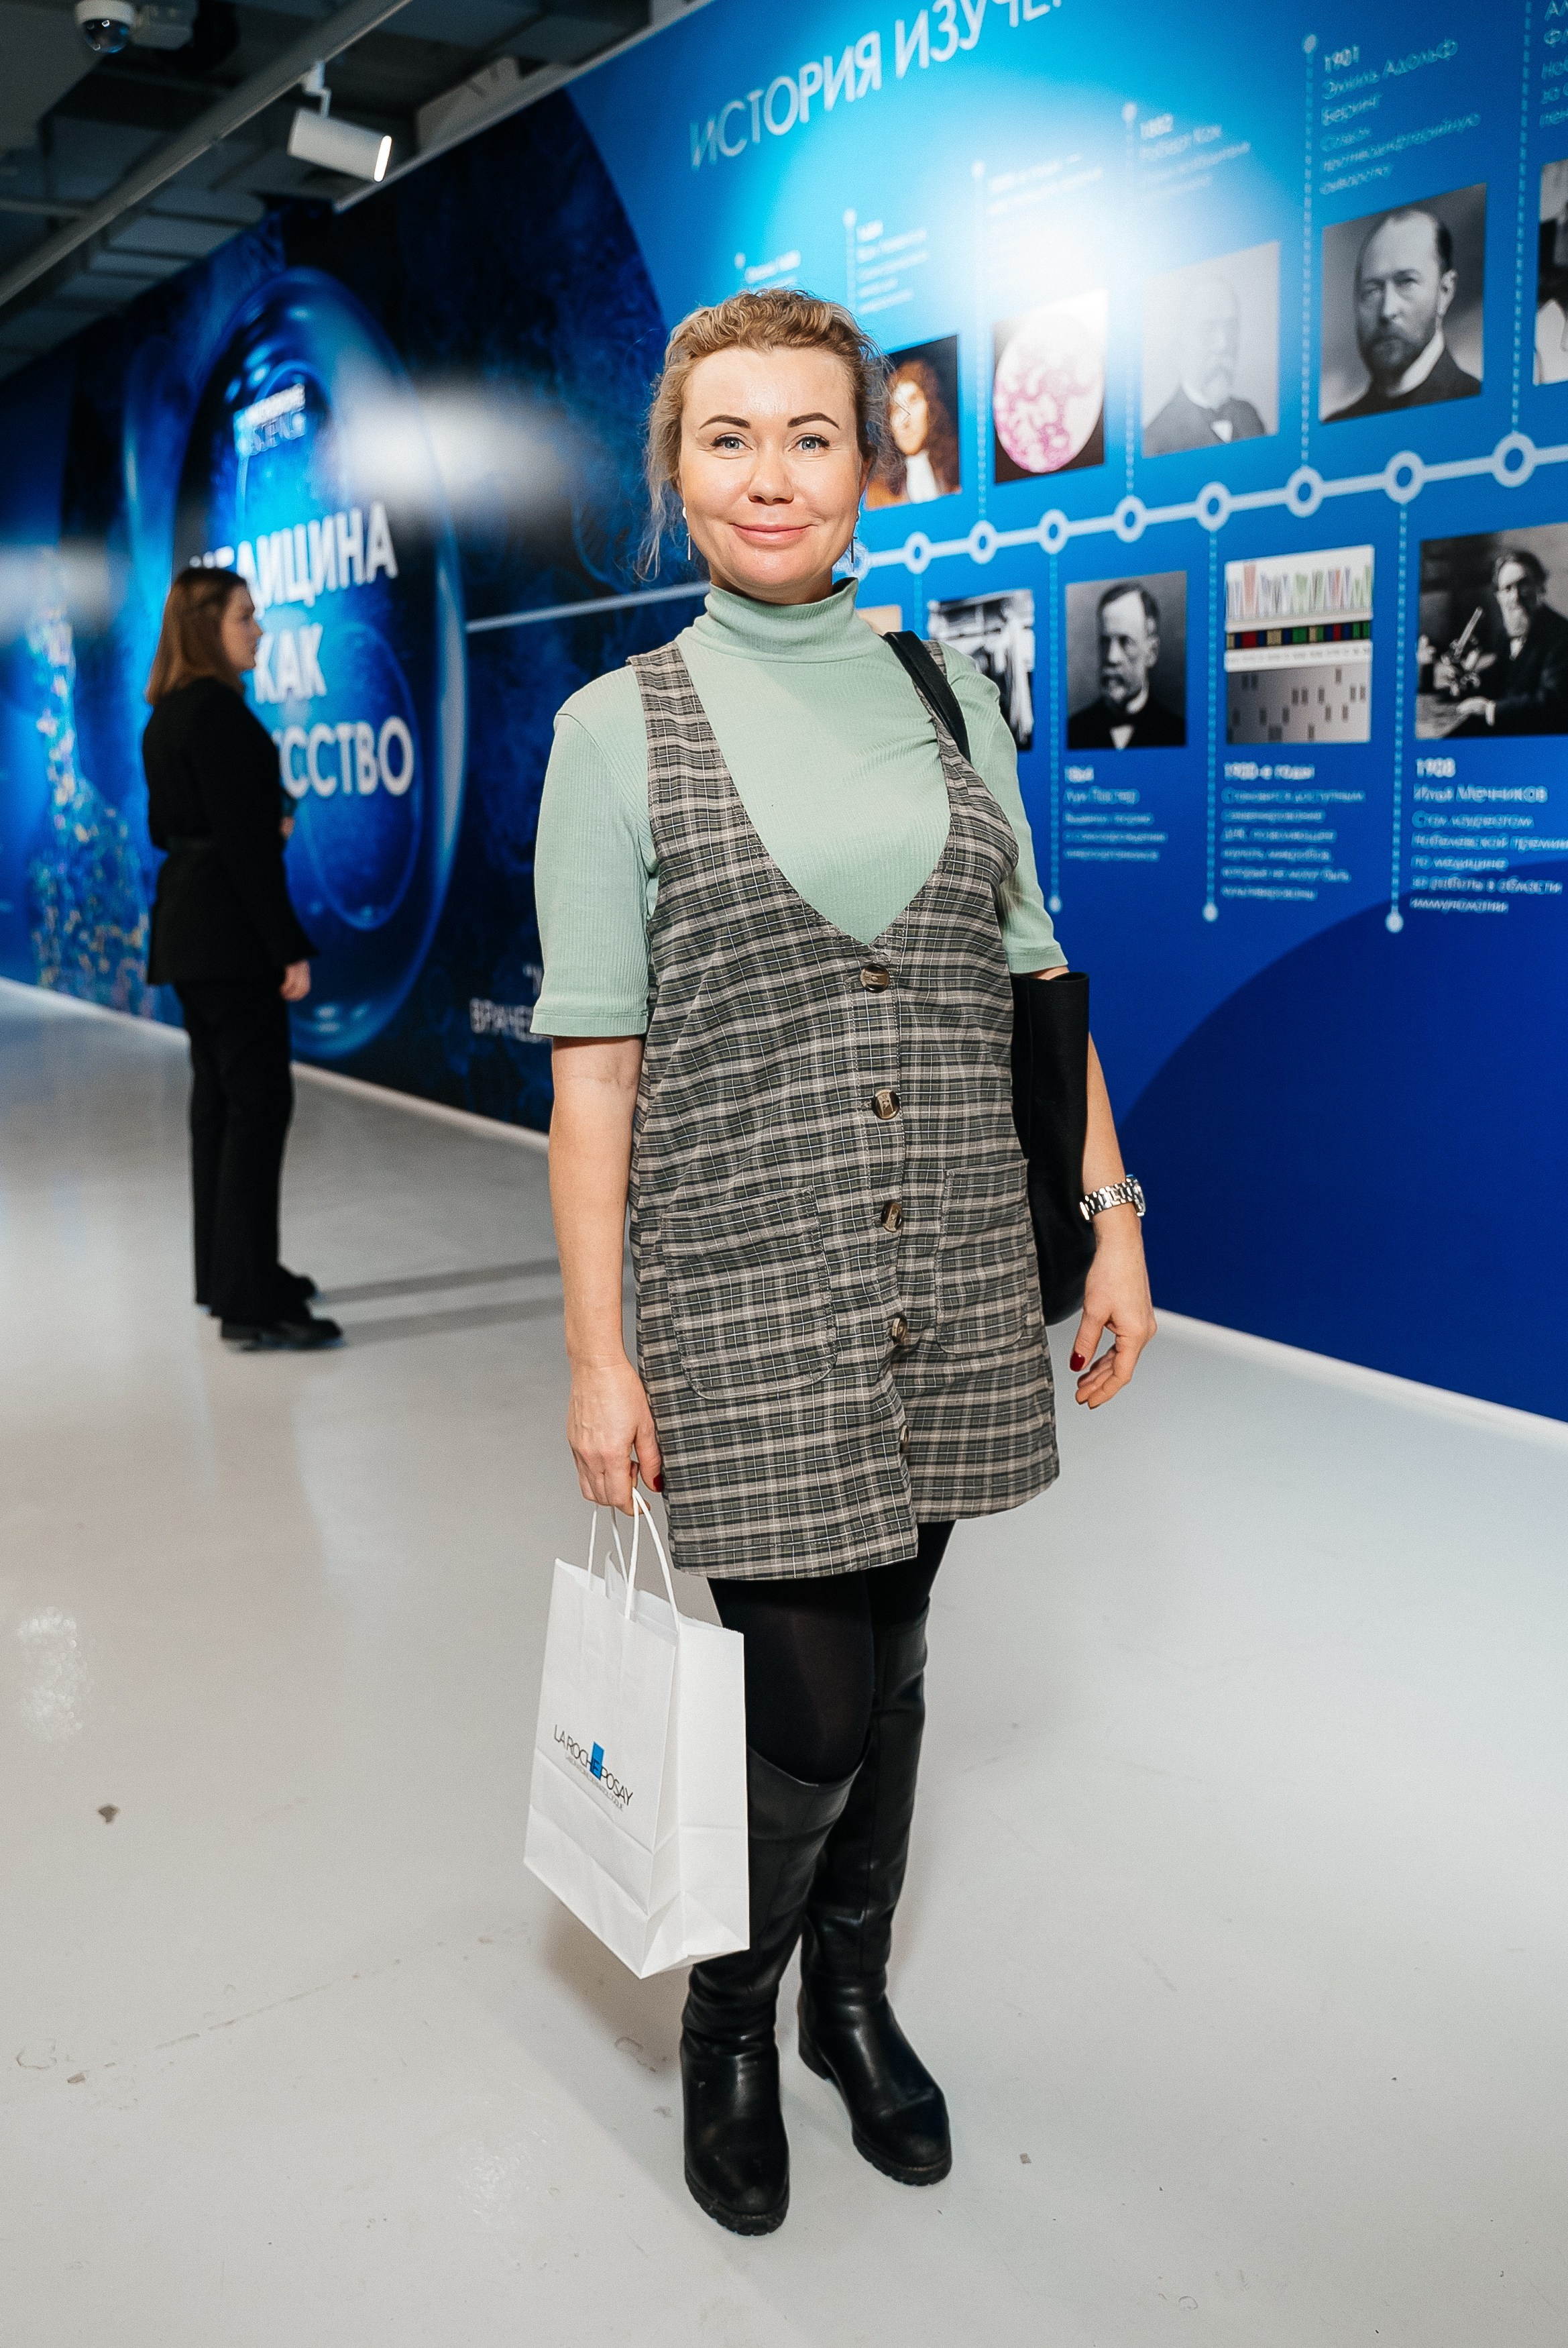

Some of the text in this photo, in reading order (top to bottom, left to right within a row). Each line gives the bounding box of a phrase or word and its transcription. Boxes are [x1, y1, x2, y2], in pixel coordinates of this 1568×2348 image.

[689, 0, 1062, 172] ИСТОРИЯ ИЗУЧ
[189, 500, 399, 621] ДИЦИНА
[254, 623, 328, 704] КАК
[271, 715, 414, 798] ССТВО
[1455, 783, 1549, 804] Мечников
[469, 997, 551, 1044] ВРАЧЕ
